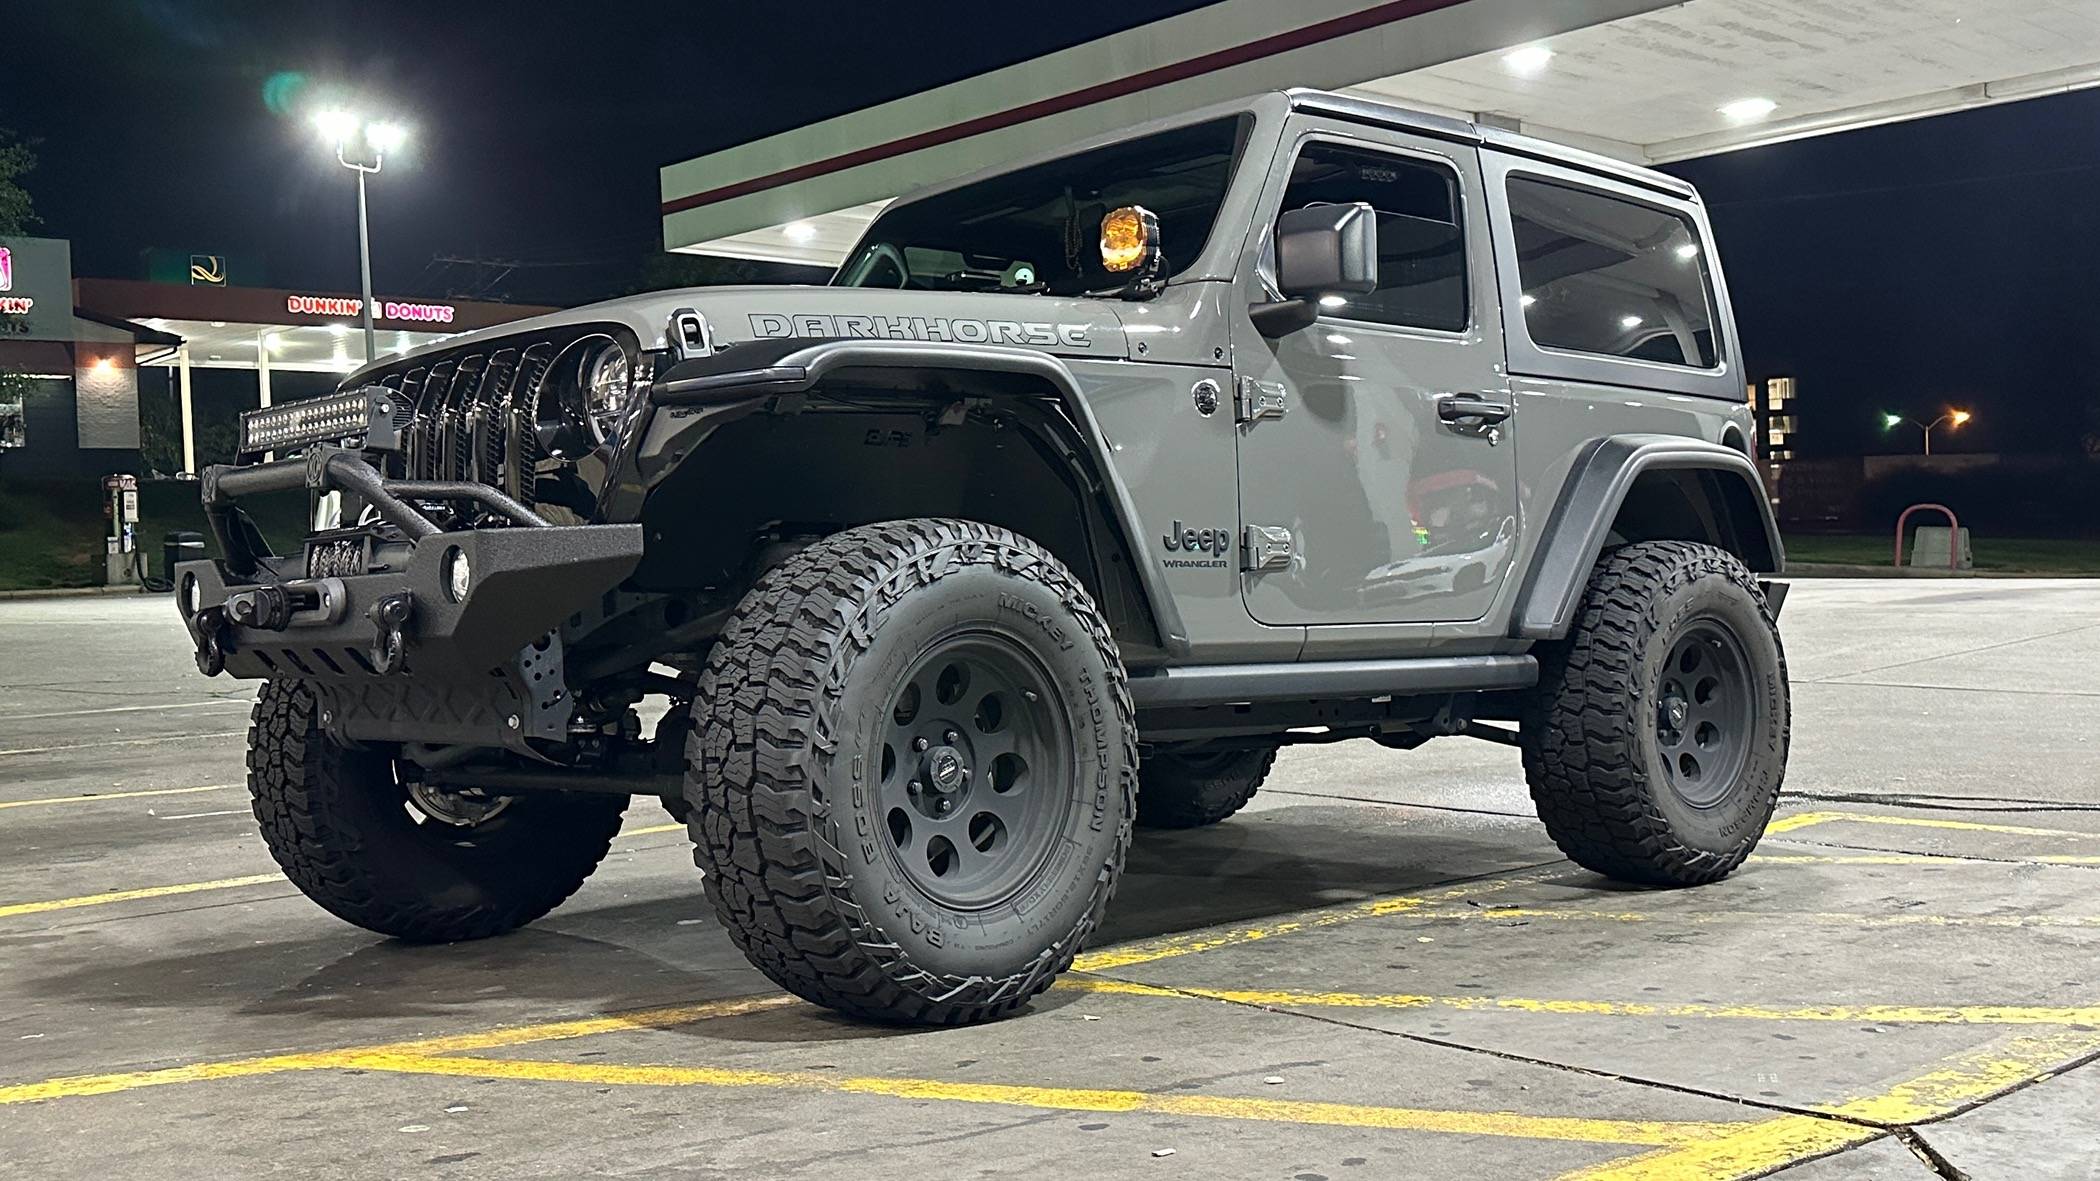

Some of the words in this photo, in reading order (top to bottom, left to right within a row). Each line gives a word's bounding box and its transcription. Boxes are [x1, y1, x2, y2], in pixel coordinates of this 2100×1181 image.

[288, 296, 363, 316] DUNKIN'
[385, 302, 454, 322] DONUTS
[747, 313, 1092, 348] DARKHORSE
[1163, 520, 1230, 557] Jeep
[1163, 559, 1227, 568] WRANGLER
[998, 592, 1074, 652] MICKEY
[1079, 666, 1108, 832] THOMPSON
